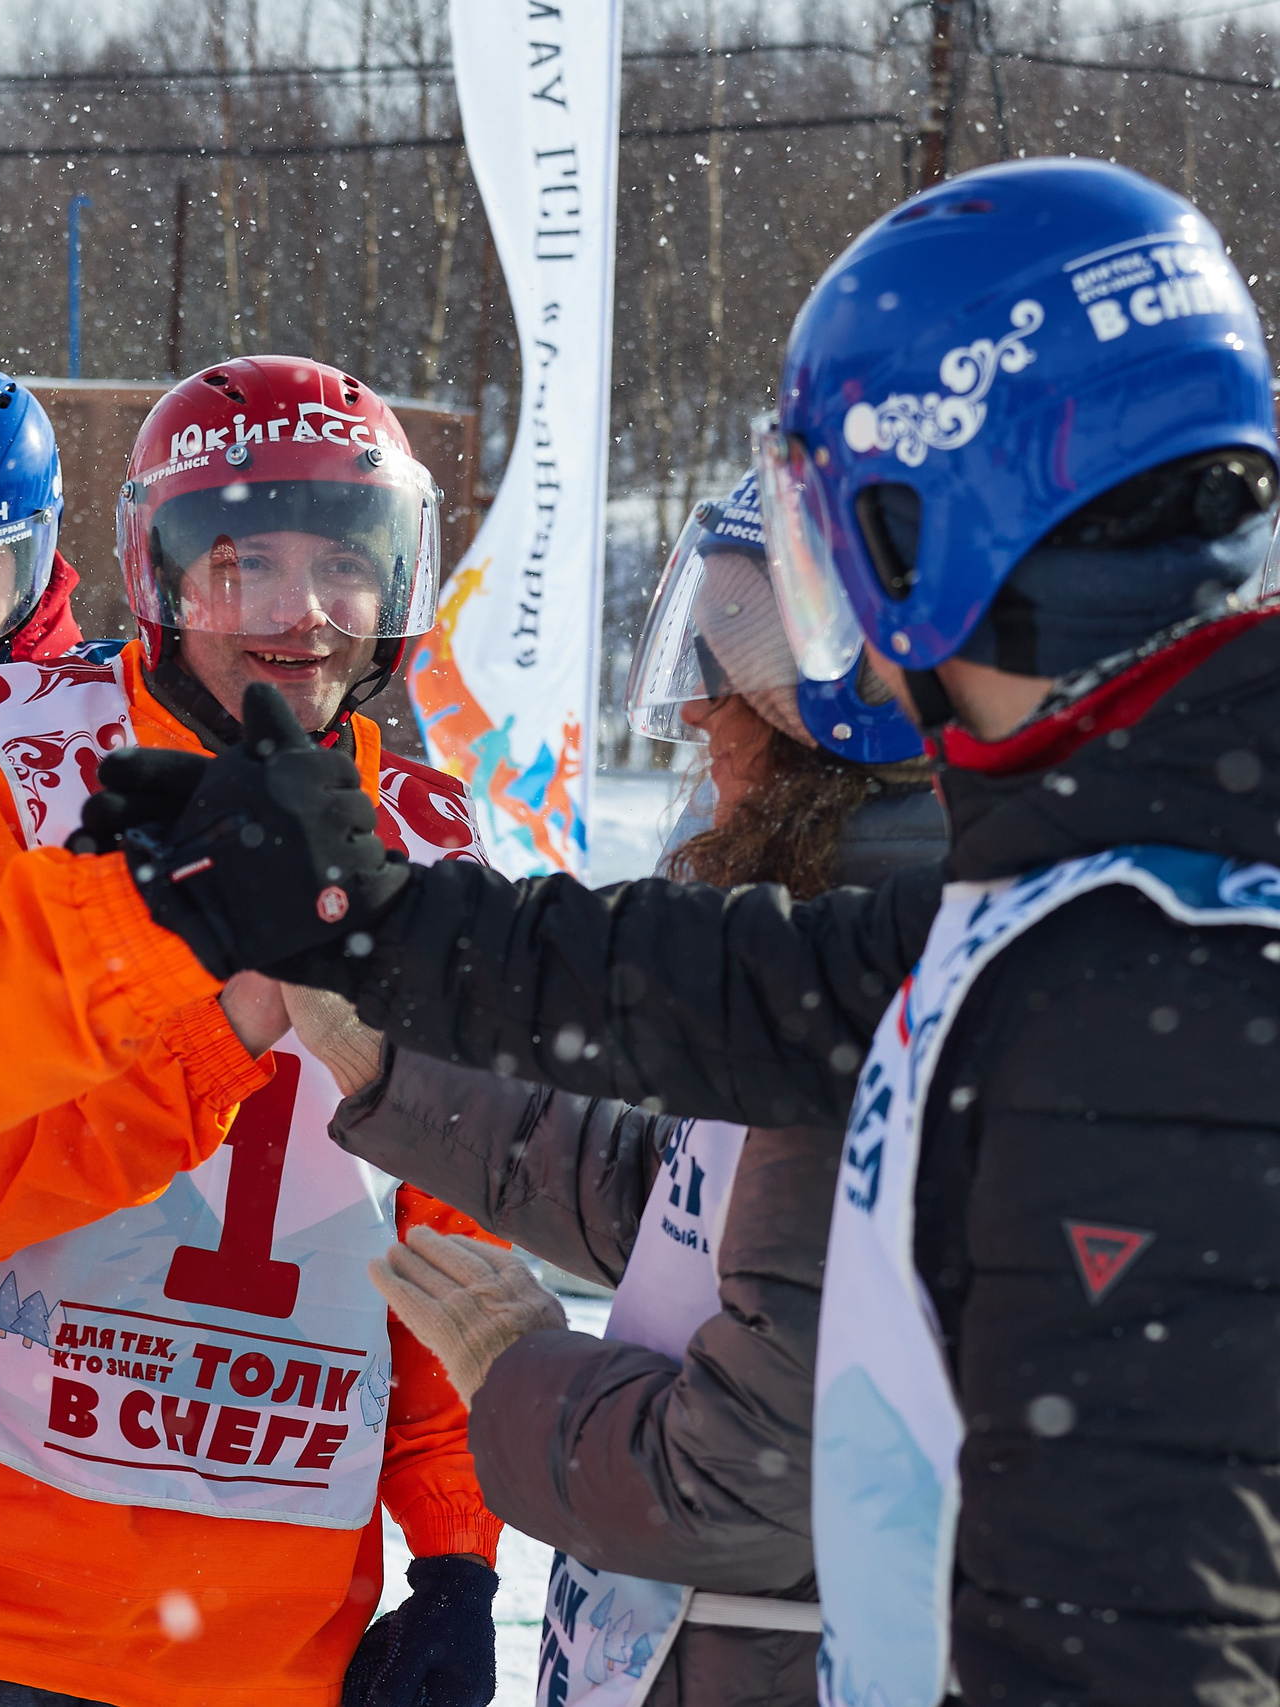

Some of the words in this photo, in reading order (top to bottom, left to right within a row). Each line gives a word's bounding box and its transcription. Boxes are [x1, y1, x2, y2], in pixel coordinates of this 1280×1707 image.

[1086, 298, 1130, 343] В
[143, 455, 211, 489] МУРМАНСК
[163, 1050, 302, 1320] 1
[55, 1322, 116, 1350] ДЛЯ
[120, 1330, 178, 1362] ТЕХ,
[53, 1350, 103, 1374] КТО
[106, 1357, 174, 1384] ЗНАЕТ
[191, 1342, 362, 1413] ТОЛК
[47, 1376, 100, 1439] В
[119, 1389, 350, 1471] СНЕГЕ
